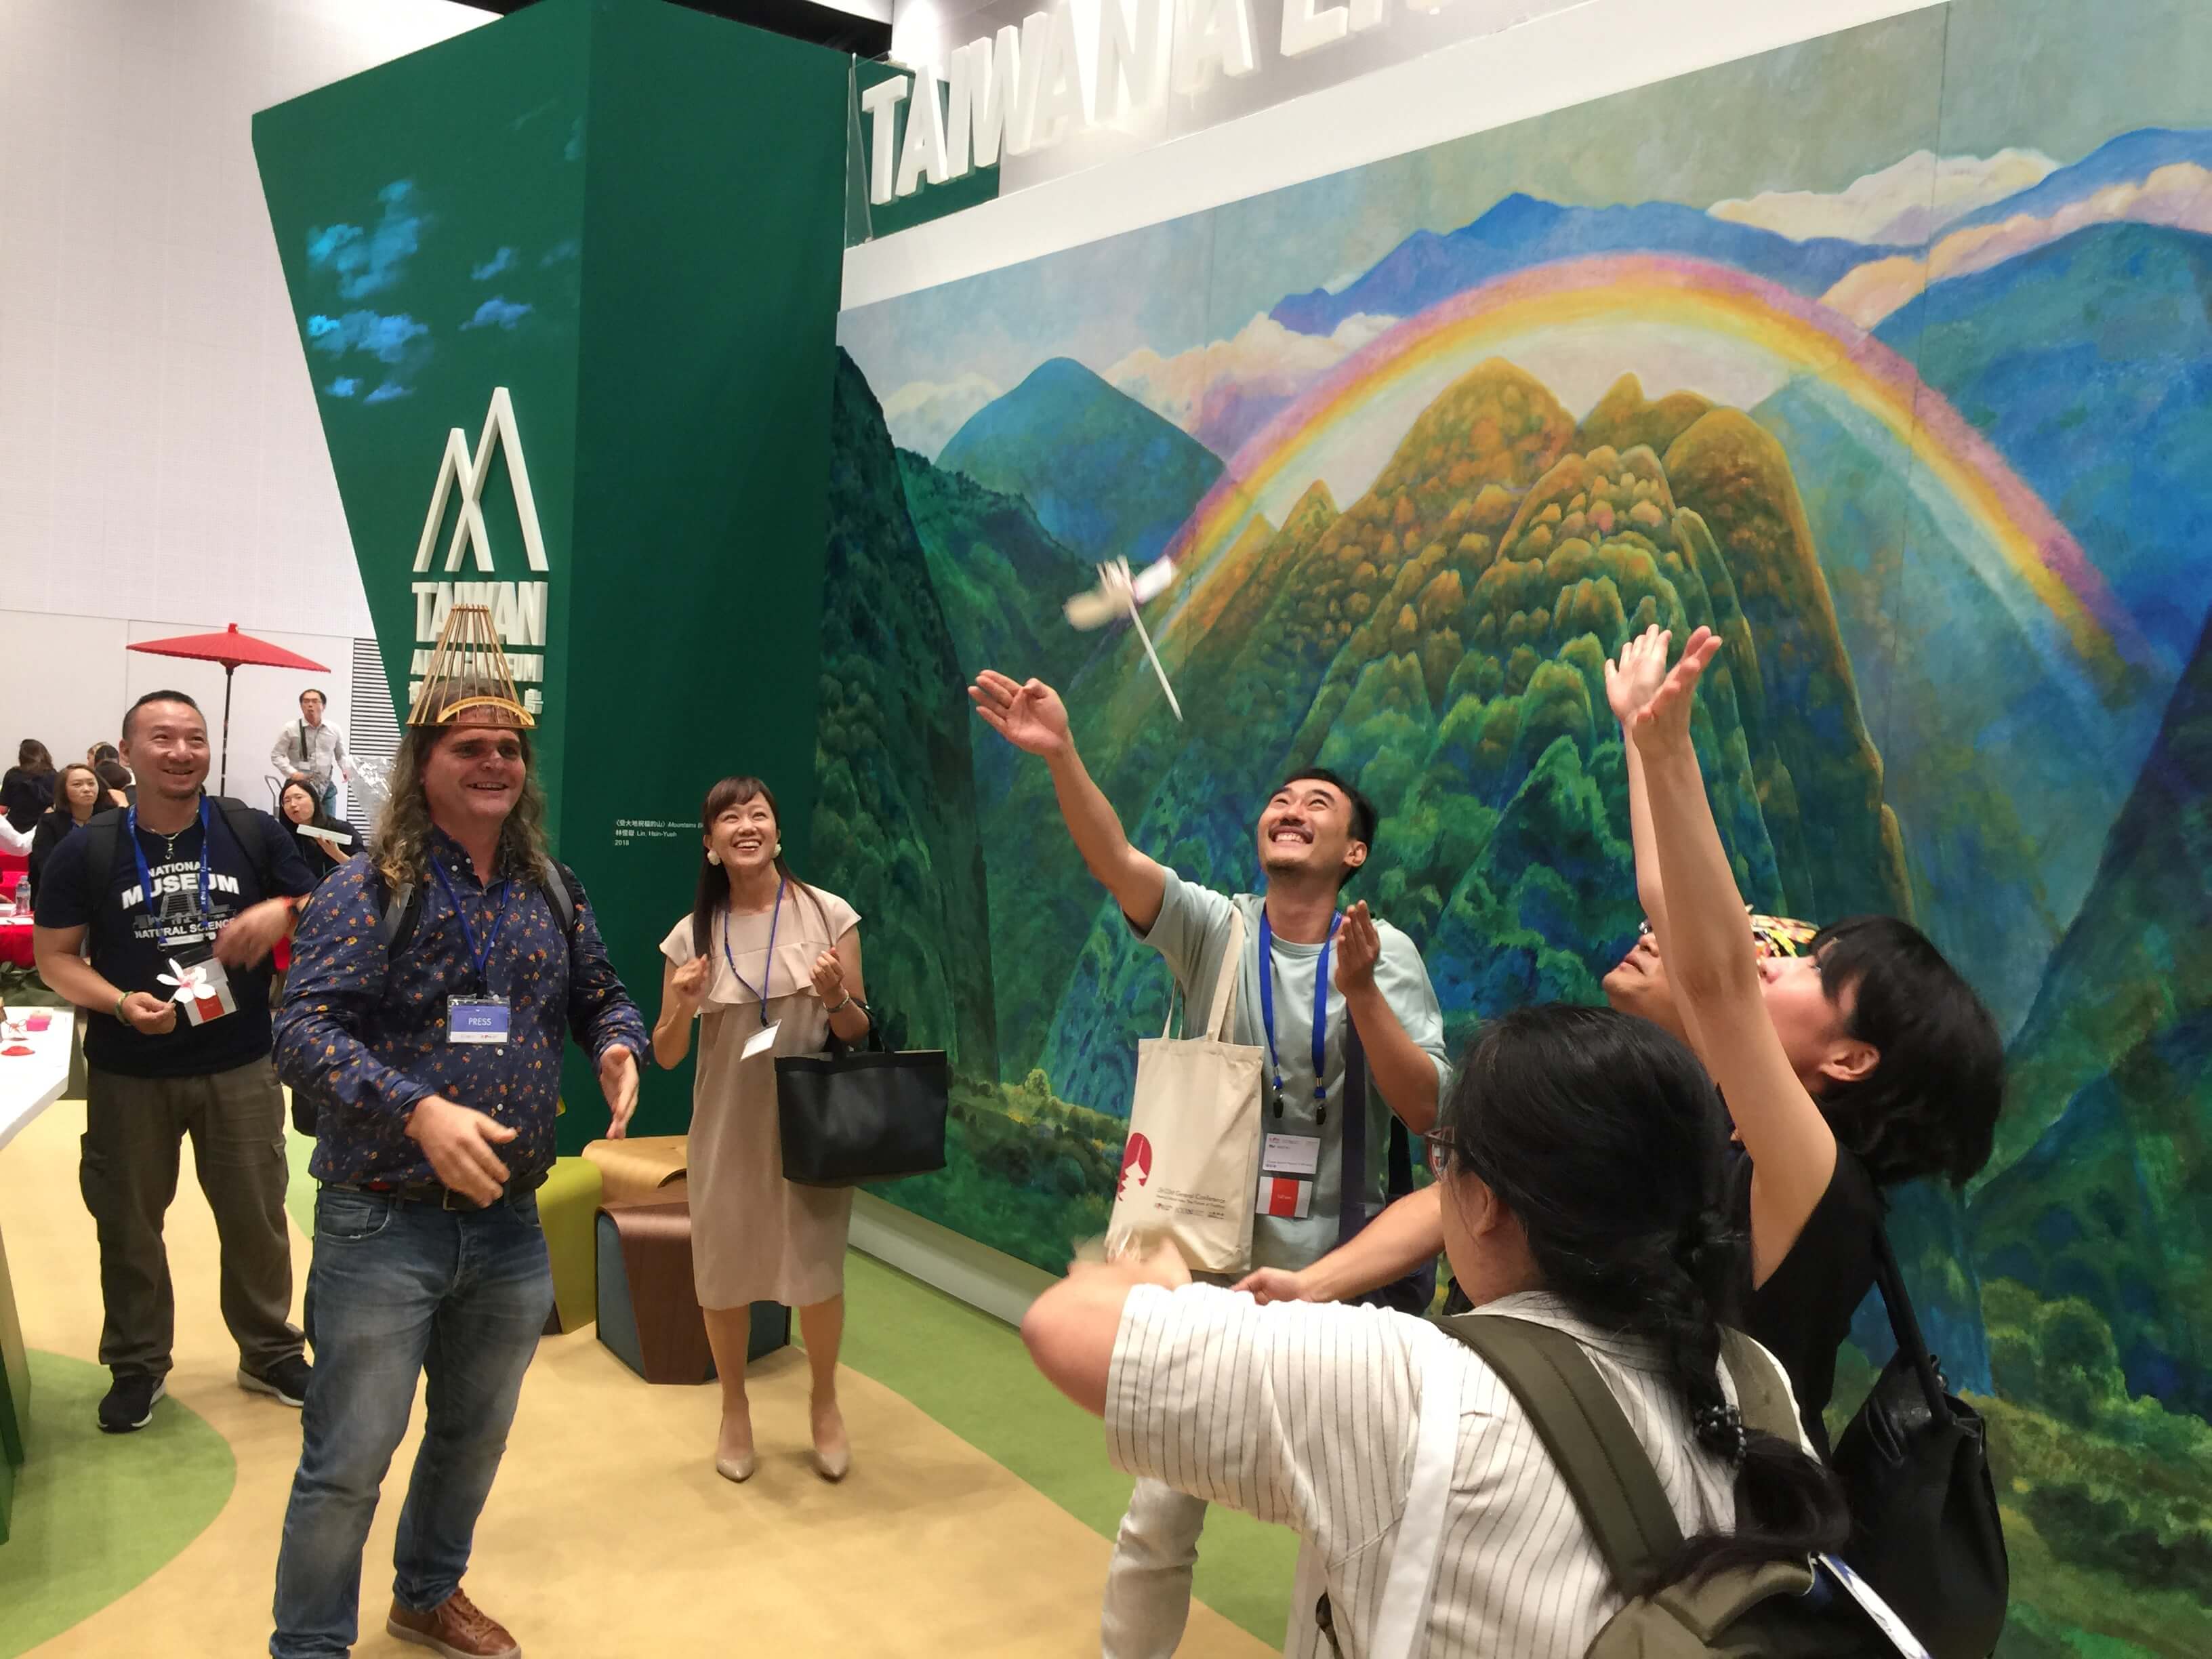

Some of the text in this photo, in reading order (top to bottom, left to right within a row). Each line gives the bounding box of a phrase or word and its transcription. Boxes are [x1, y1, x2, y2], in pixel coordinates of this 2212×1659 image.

[861, 0, 1168, 206] TAIWAN
[411, 581, 548, 646] TAIWAN
[148, 861, 212, 878] NATIONA
[468, 1017, 492, 1026] PRESS
